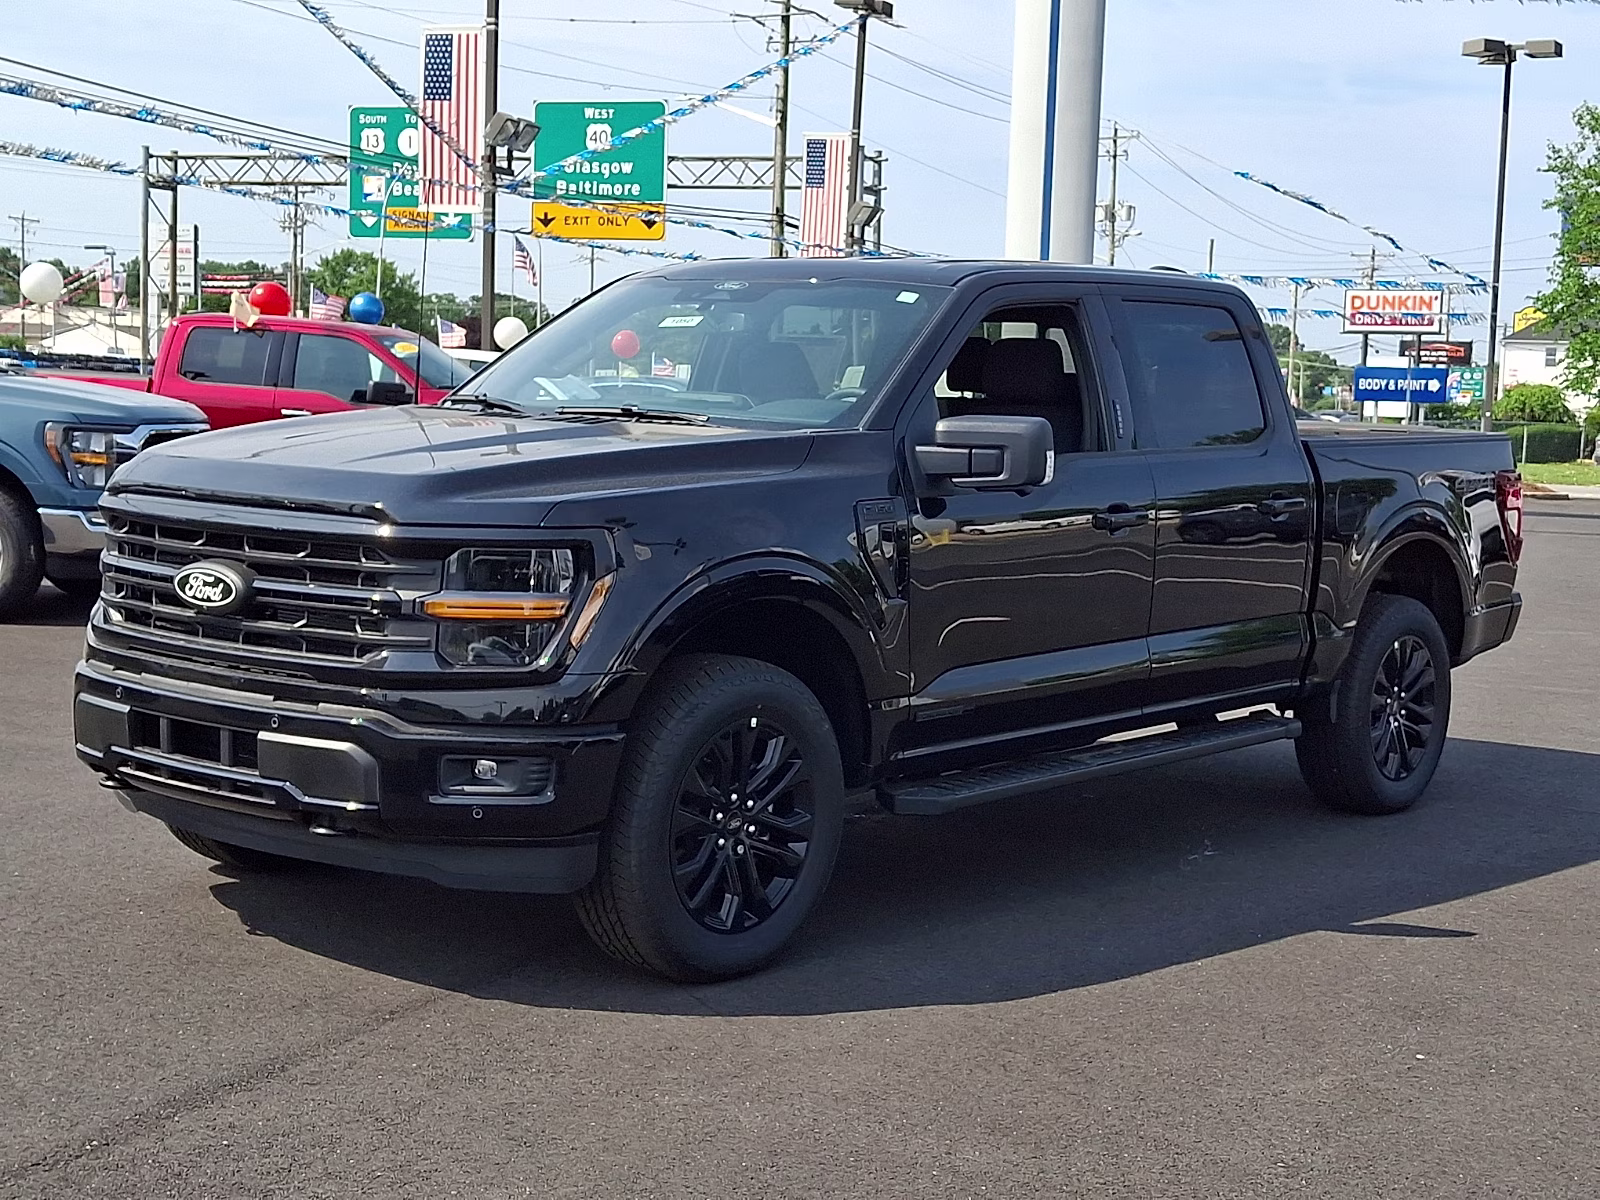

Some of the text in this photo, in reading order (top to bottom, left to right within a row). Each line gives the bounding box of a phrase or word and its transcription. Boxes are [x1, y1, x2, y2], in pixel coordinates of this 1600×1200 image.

[358, 114, 387, 124] SOUTH
[584, 107, 615, 119] WEST
[366, 134, 379, 148] 13
[589, 130, 609, 146] 40
[564, 161, 634, 179] Glasgow
[556, 180, 641, 196] Baltimore
[564, 216, 630, 227] EXIT ONLY
[1351, 295, 1439, 311] DUNKIN'
[1358, 378, 1427, 391] BODY & PAINT
[184, 572, 224, 602] Ford
